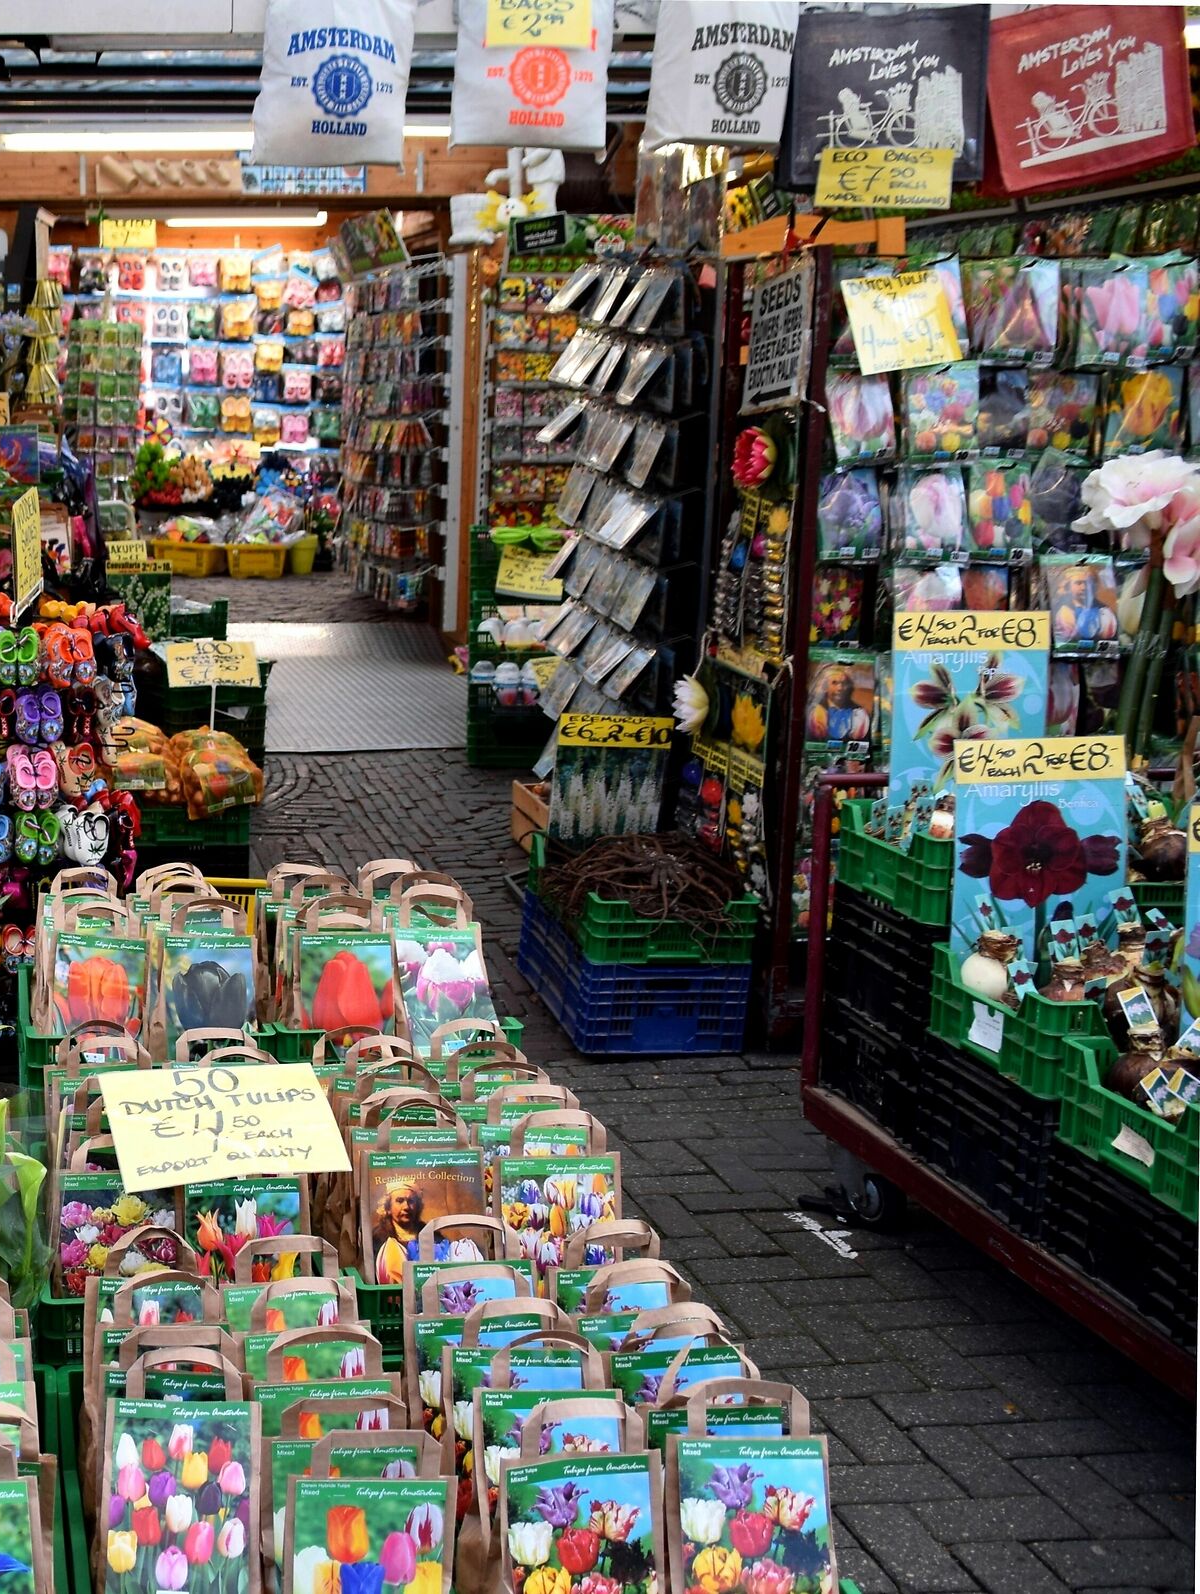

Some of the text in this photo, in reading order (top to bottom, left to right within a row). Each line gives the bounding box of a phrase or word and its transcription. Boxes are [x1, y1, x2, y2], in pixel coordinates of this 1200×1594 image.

[692, 22, 794, 52] AMSTERDAM
[287, 27, 396, 64] AMSTERDAM
[1017, 24, 1111, 75] AMSTERDAM
[829, 40, 919, 67] AMSTERDAM
[509, 111, 564, 127] HOLLAND
[711, 119, 760, 134] HOLLAND
[311, 120, 367, 135] HOLLAND
[832, 151, 933, 163] ECO BAGS
[760, 274, 801, 316] SEEDS
[977, 627, 1000, 638] FOR
[196, 643, 232, 655] 100
[901, 650, 989, 673] Amaryllis
[987, 766, 1022, 778] EACH
[1044, 753, 1069, 768] FOR
[964, 782, 1060, 806] Amaryllis
[171, 1068, 240, 1097] 50
[119, 1088, 316, 1116] DUTCH TULIPS
[245, 1128, 293, 1140] EACH
[137, 1155, 213, 1177] EXPORT
[375, 1170, 475, 1185] Rembrandt Collection
[309, 1388, 387, 1399] Tulips from Amsterdam
[172, 1408, 248, 1418] Tulips from Amsterdam
[738, 1446, 819, 1457] Tulips from Amsterdam
[563, 1462, 646, 1474] Tulips from Amsterdam
[301, 1488, 319, 1496] Mixed
[356, 1488, 442, 1498] Tulips from Amsterdam
